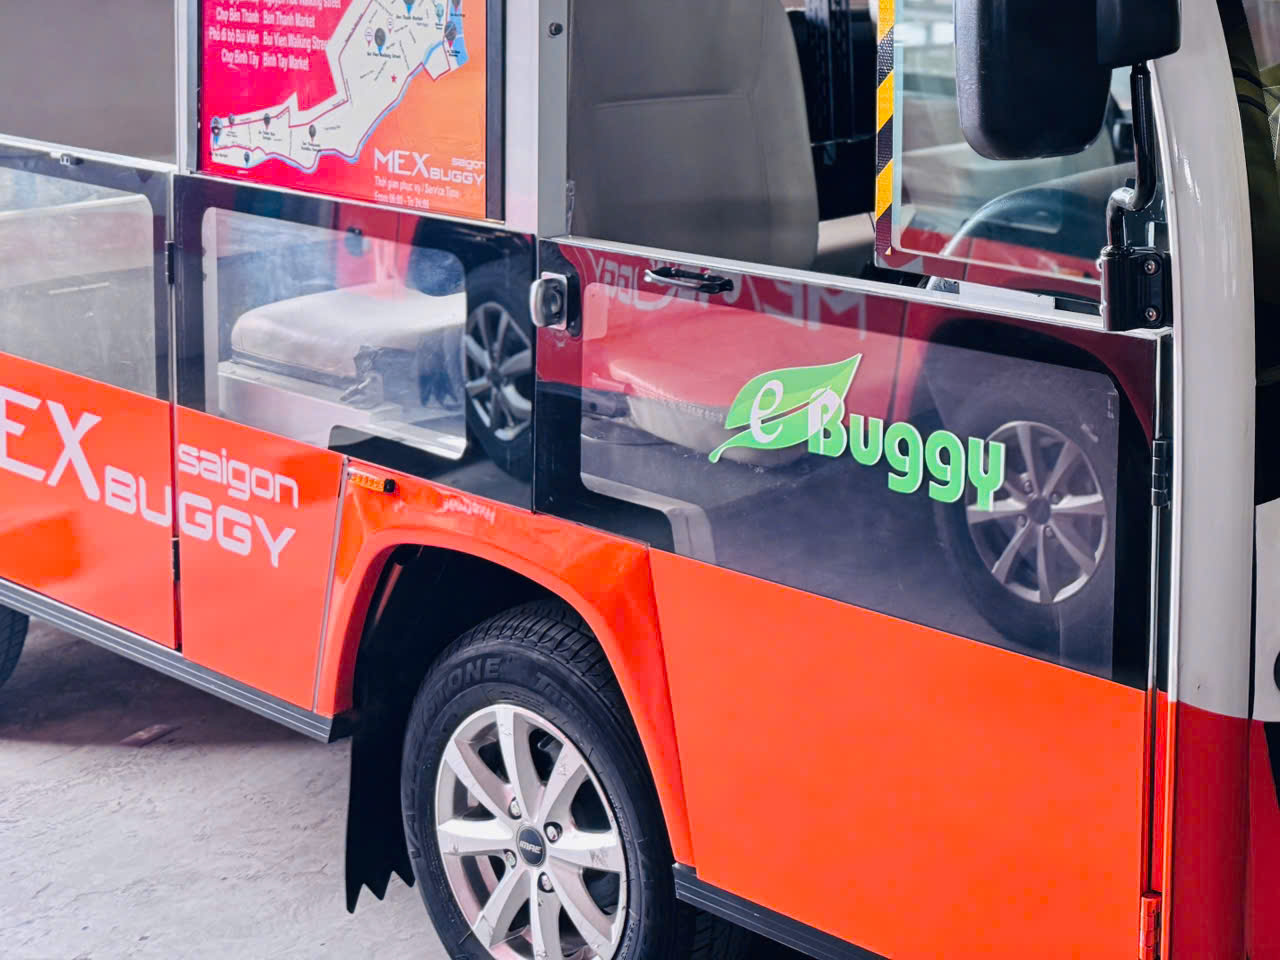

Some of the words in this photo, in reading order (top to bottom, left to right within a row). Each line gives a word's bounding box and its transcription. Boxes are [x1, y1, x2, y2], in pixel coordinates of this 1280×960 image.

[295, 13, 315, 28] Market
[288, 32, 311, 53] Walking
[374, 146, 431, 179] MEX
[430, 167, 485, 187] BUGGY
[177, 442, 300, 509] saigon
[104, 464, 297, 569] BUGGY
